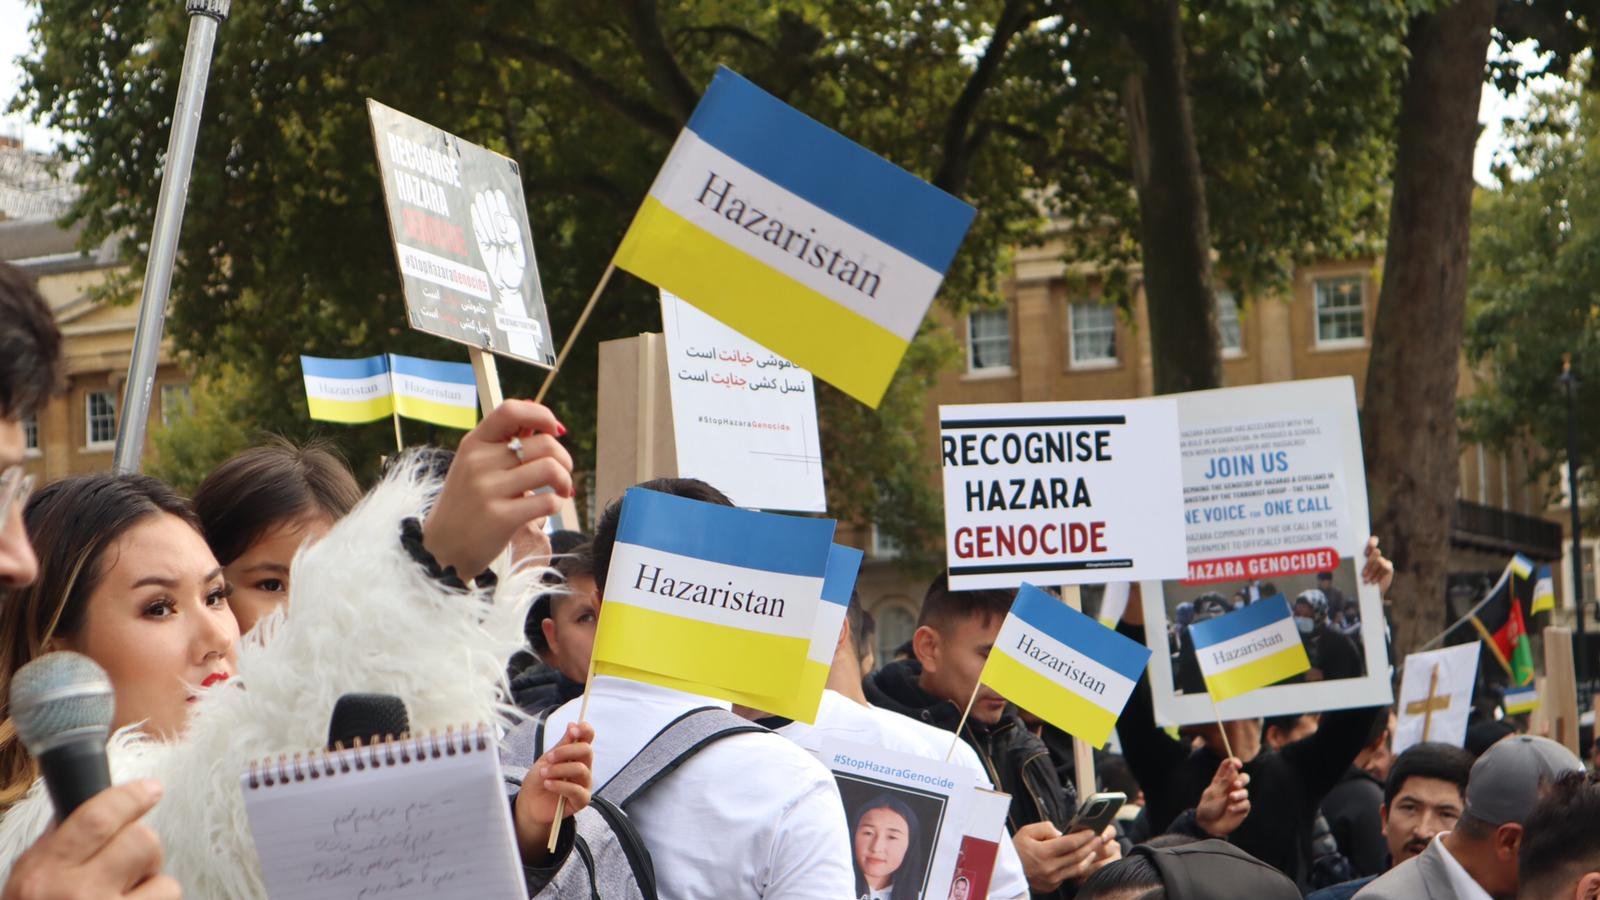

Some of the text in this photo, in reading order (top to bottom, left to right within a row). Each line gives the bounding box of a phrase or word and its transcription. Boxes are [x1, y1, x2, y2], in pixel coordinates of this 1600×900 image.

[387, 132, 461, 188] RECOGNISE
[394, 168, 450, 218] HAZARA
[695, 171, 881, 298] Hazaristan
[686, 346, 716, 360] است
[719, 350, 754, 367] خیانت
[319, 382, 379, 396] Hazaristan
[678, 369, 709, 382] است
[780, 379, 806, 394] نسل
[404, 380, 462, 401] Hazaristan
[699, 416, 790, 431] #StopHazaraGenocide
[941, 430, 1112, 467] RECOGNISE
[1205, 451, 1289, 479] JOIN US
[965, 477, 1092, 513] HAZARA
[1184, 509, 1200, 525] NE
[1203, 503, 1246, 523] VOICE
[1264, 499, 1293, 517] ONE
[1297, 496, 1332, 513] CALL
[954, 521, 1108, 559] GENOCIDE
[1213, 526, 1256, 540] COMMUNITY
[1187, 551, 1333, 580] HAZARA GENOCIDE!
[632, 563, 785, 618] Hazaristan
[1213, 632, 1284, 665] Hazaristan
[1016, 633, 1106, 695] Hazaristan
[833, 754, 954, 789] #StopHazaraGenocide
